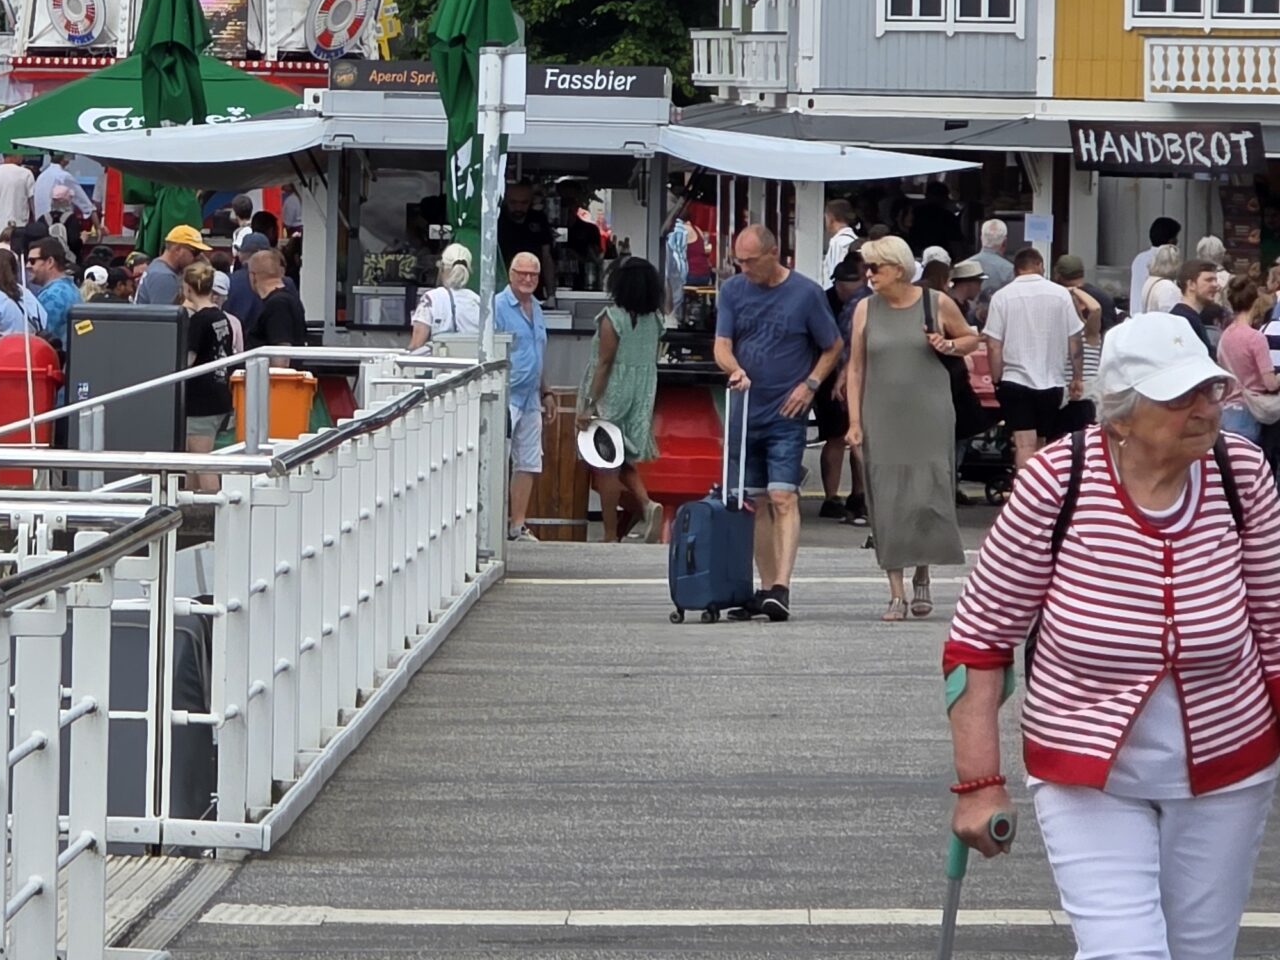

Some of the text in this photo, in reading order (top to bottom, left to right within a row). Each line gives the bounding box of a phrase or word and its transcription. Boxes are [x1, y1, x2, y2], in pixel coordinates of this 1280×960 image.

[369, 69, 408, 85] Aperol
[410, 70, 439, 86] Spri
[545, 68, 637, 91] Fassbier
[1078, 128, 1254, 168] HANDBROT
